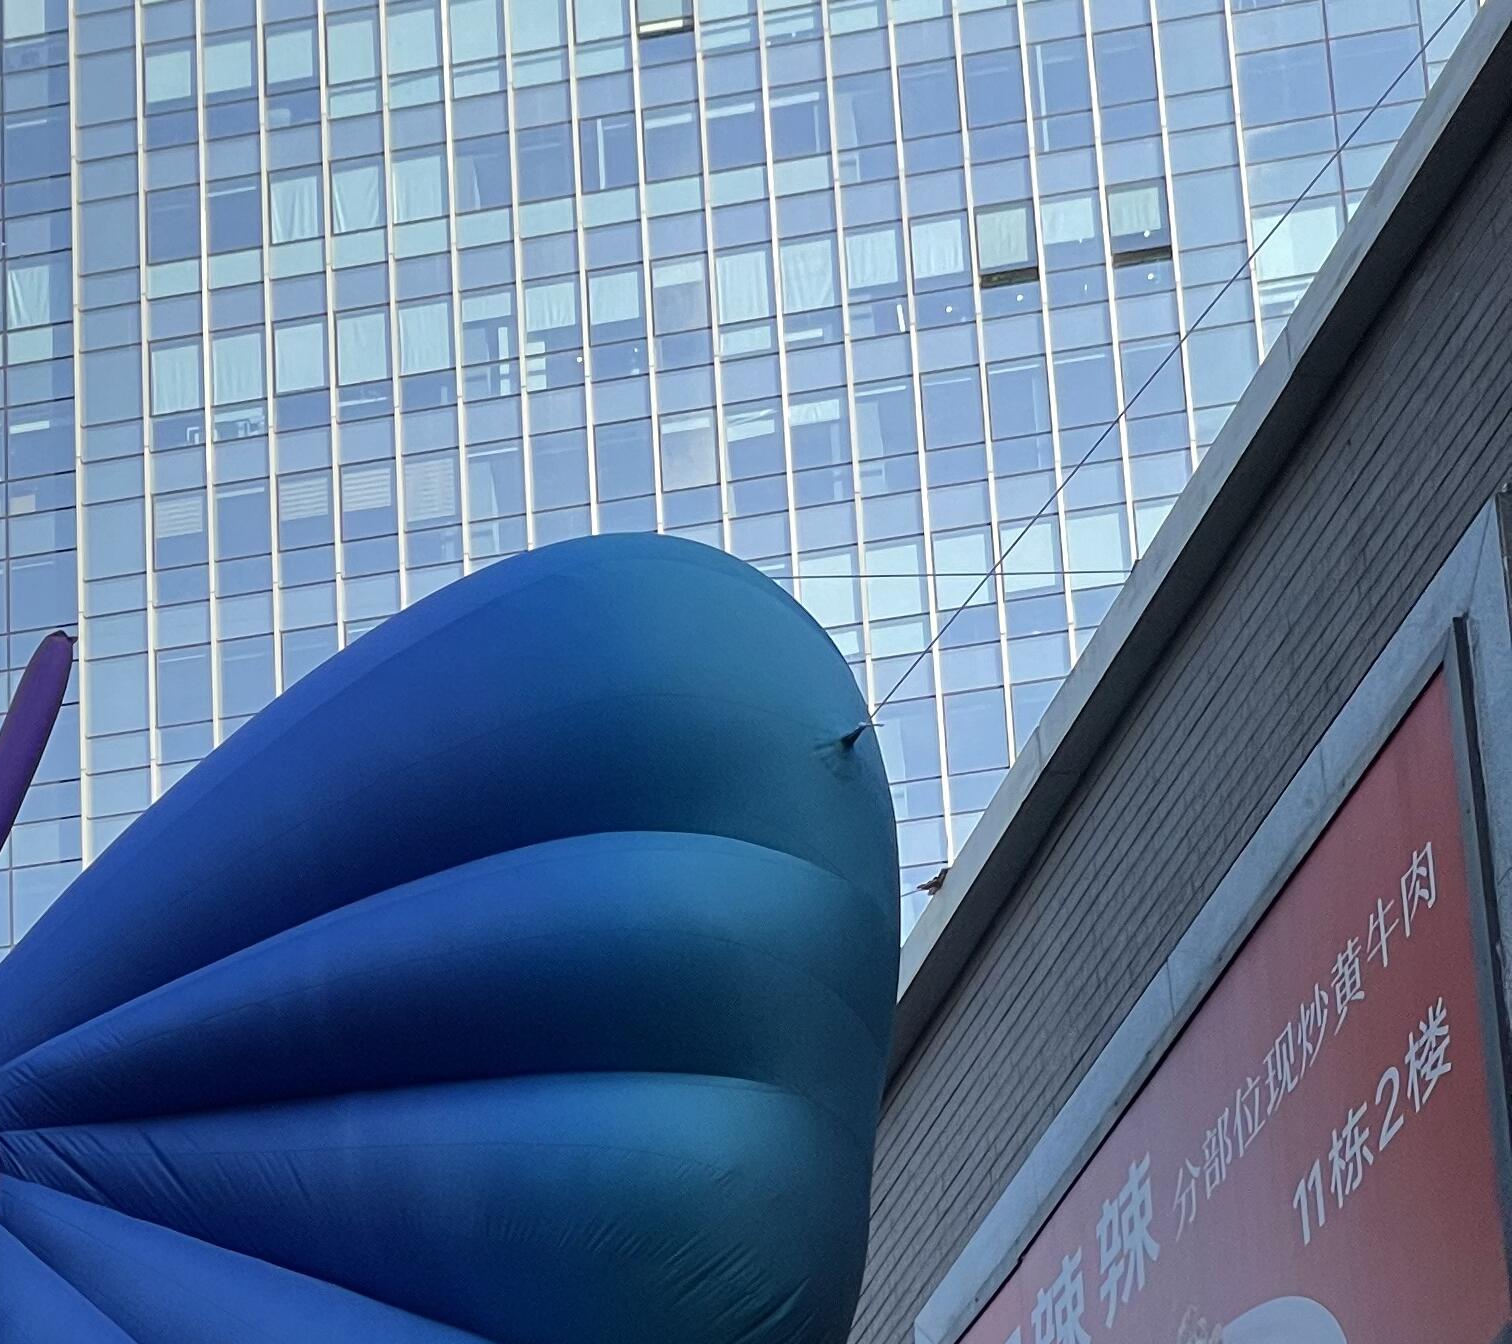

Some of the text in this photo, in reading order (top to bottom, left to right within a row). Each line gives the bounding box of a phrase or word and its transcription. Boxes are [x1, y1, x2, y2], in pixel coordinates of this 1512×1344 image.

[1172, 841, 1437, 1243] 分部位现炒黄牛肉
[1292, 996, 1452, 1247] 11栋2楼
